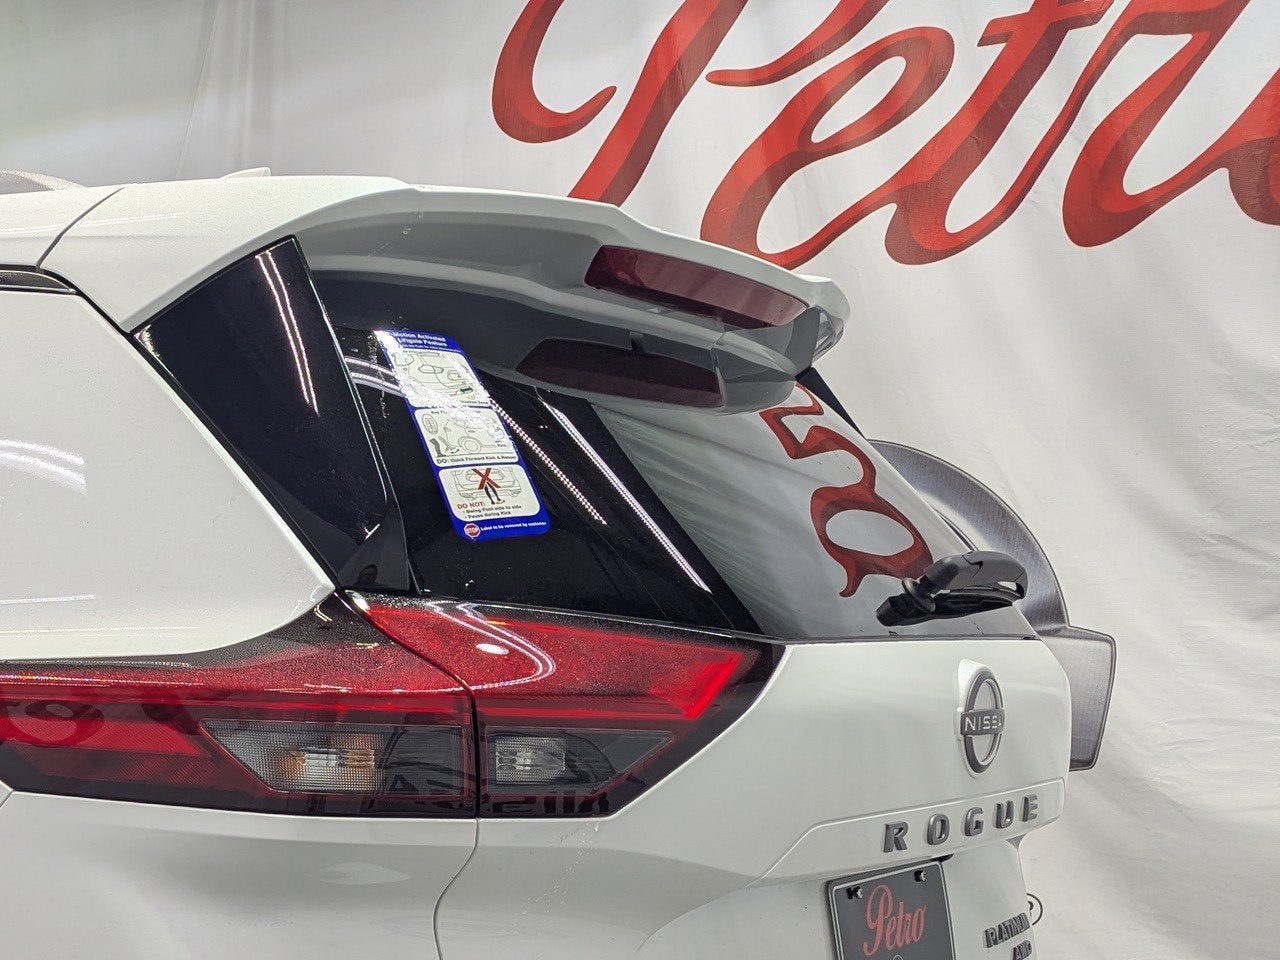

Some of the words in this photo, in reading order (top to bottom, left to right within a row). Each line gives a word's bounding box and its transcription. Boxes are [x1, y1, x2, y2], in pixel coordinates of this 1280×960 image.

[491, 0, 1280, 270] Petr
[417, 333, 446, 342] Activated
[465, 527, 478, 535] STOP
[964, 714, 1003, 732] NISS
[882, 794, 1040, 853] ROGUE
[863, 884, 927, 957] Petro
